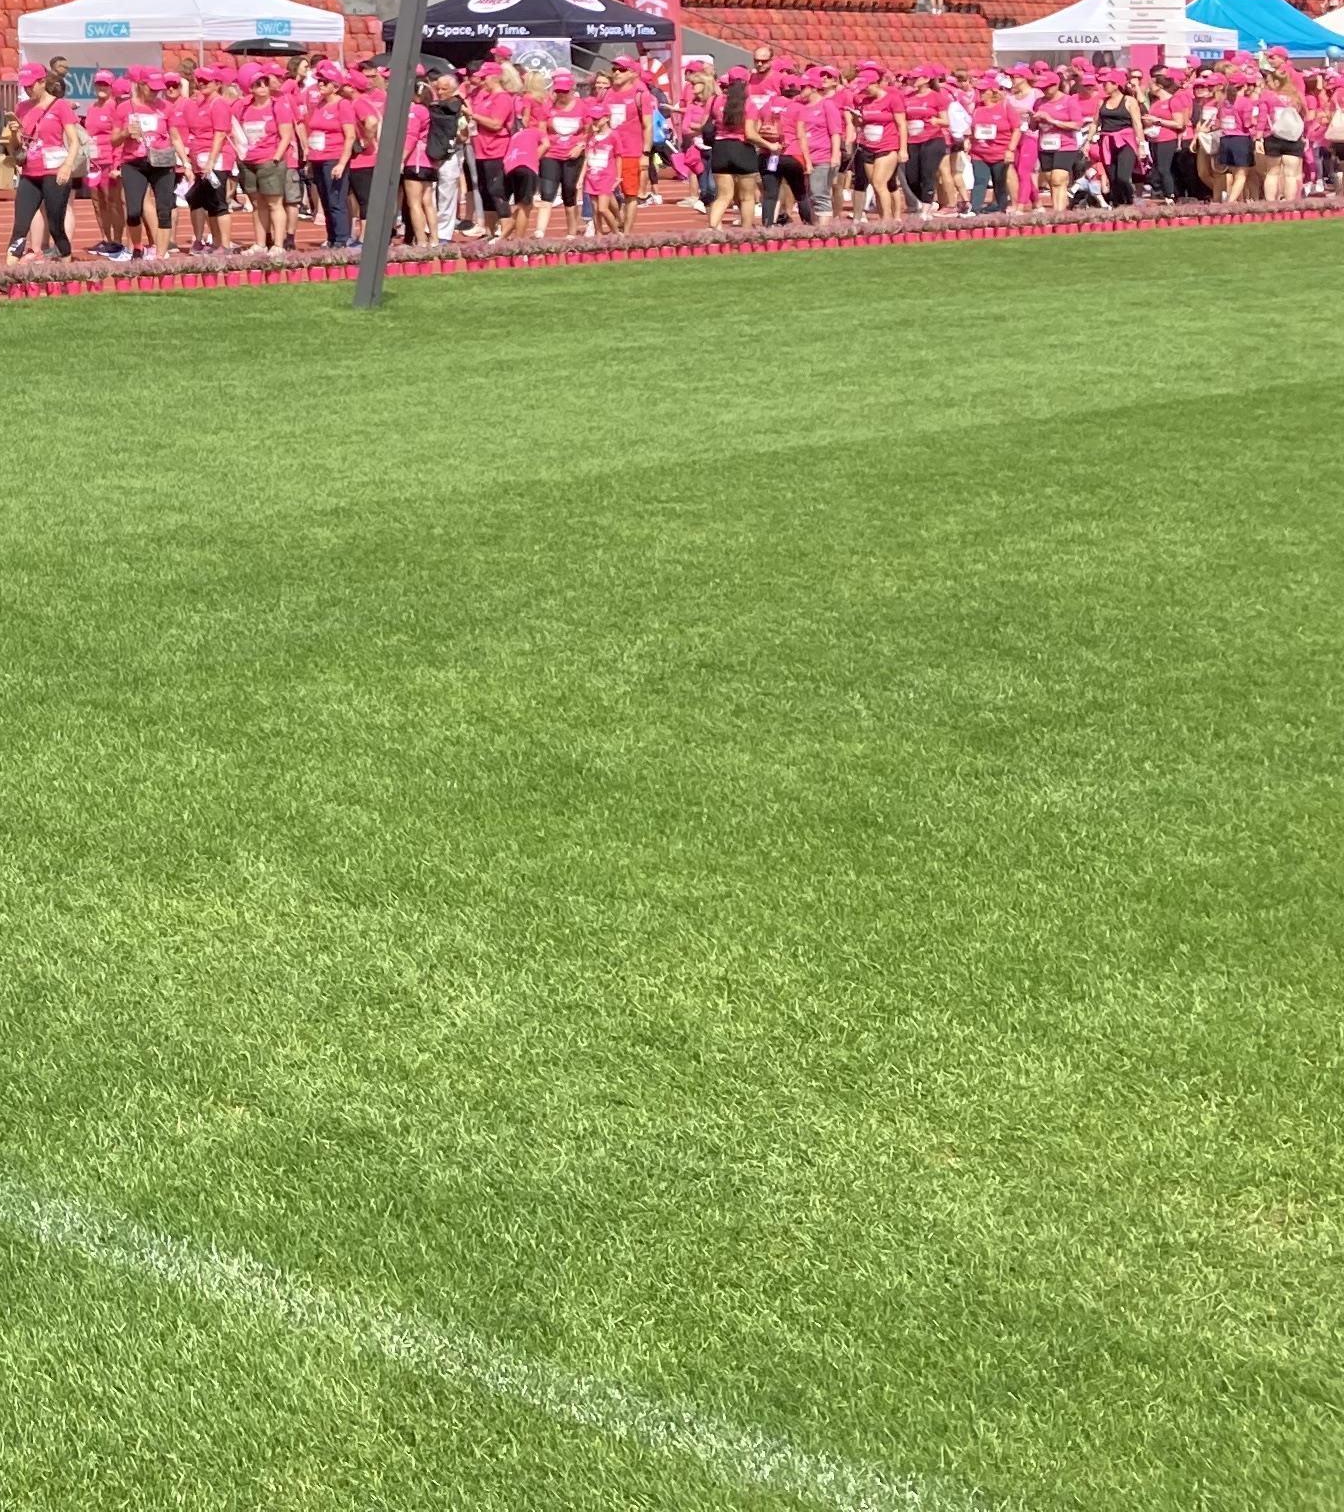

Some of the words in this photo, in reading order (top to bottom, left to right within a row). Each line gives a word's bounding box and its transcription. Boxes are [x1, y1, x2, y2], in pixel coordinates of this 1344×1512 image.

[437, 24, 475, 38] Space,
[477, 24, 496, 37] My
[496, 24, 530, 35] Time.
[1058, 35, 1100, 44] CALIDA
